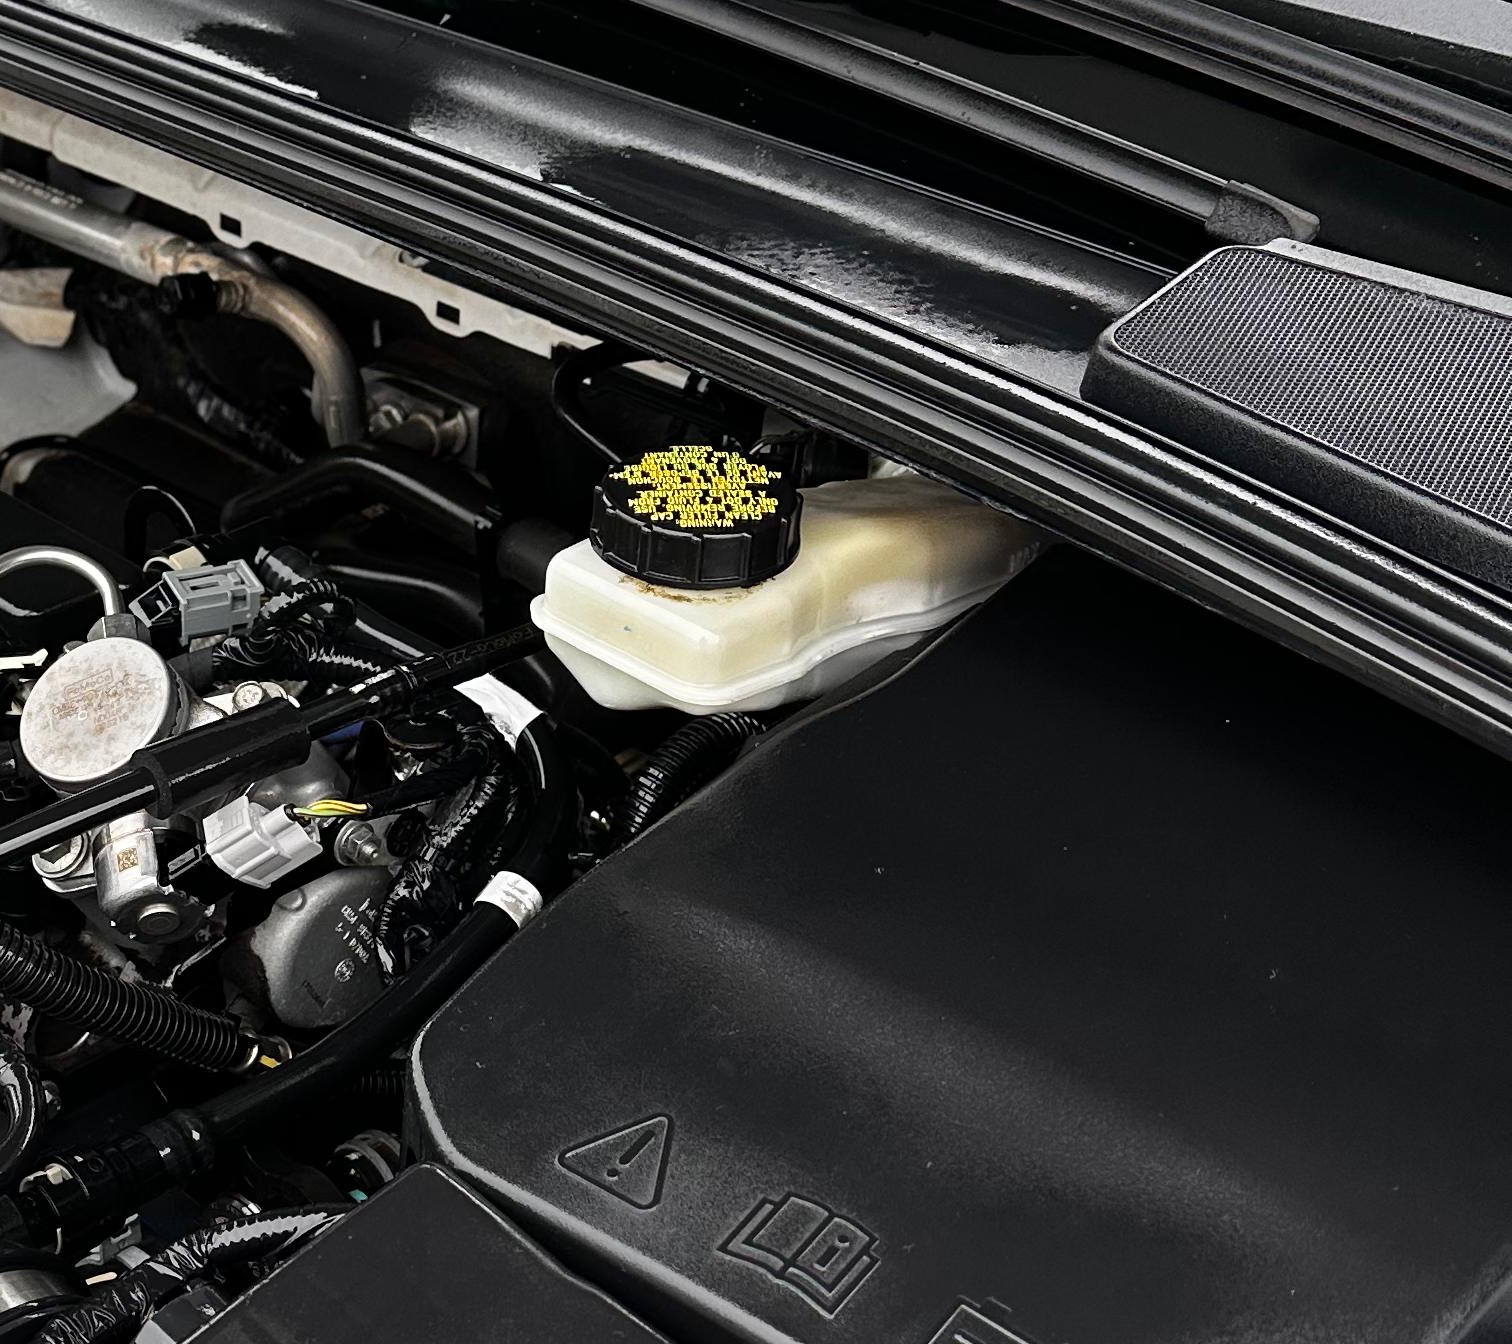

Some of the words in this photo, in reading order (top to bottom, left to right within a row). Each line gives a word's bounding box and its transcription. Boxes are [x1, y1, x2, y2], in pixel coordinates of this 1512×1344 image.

[749, 497, 778, 505] ONLY
[732, 505, 775, 513] BEFORE
[650, 512, 673, 520] CAP
[680, 511, 718, 519] FILLER
[725, 511, 762, 520] CLEAN
